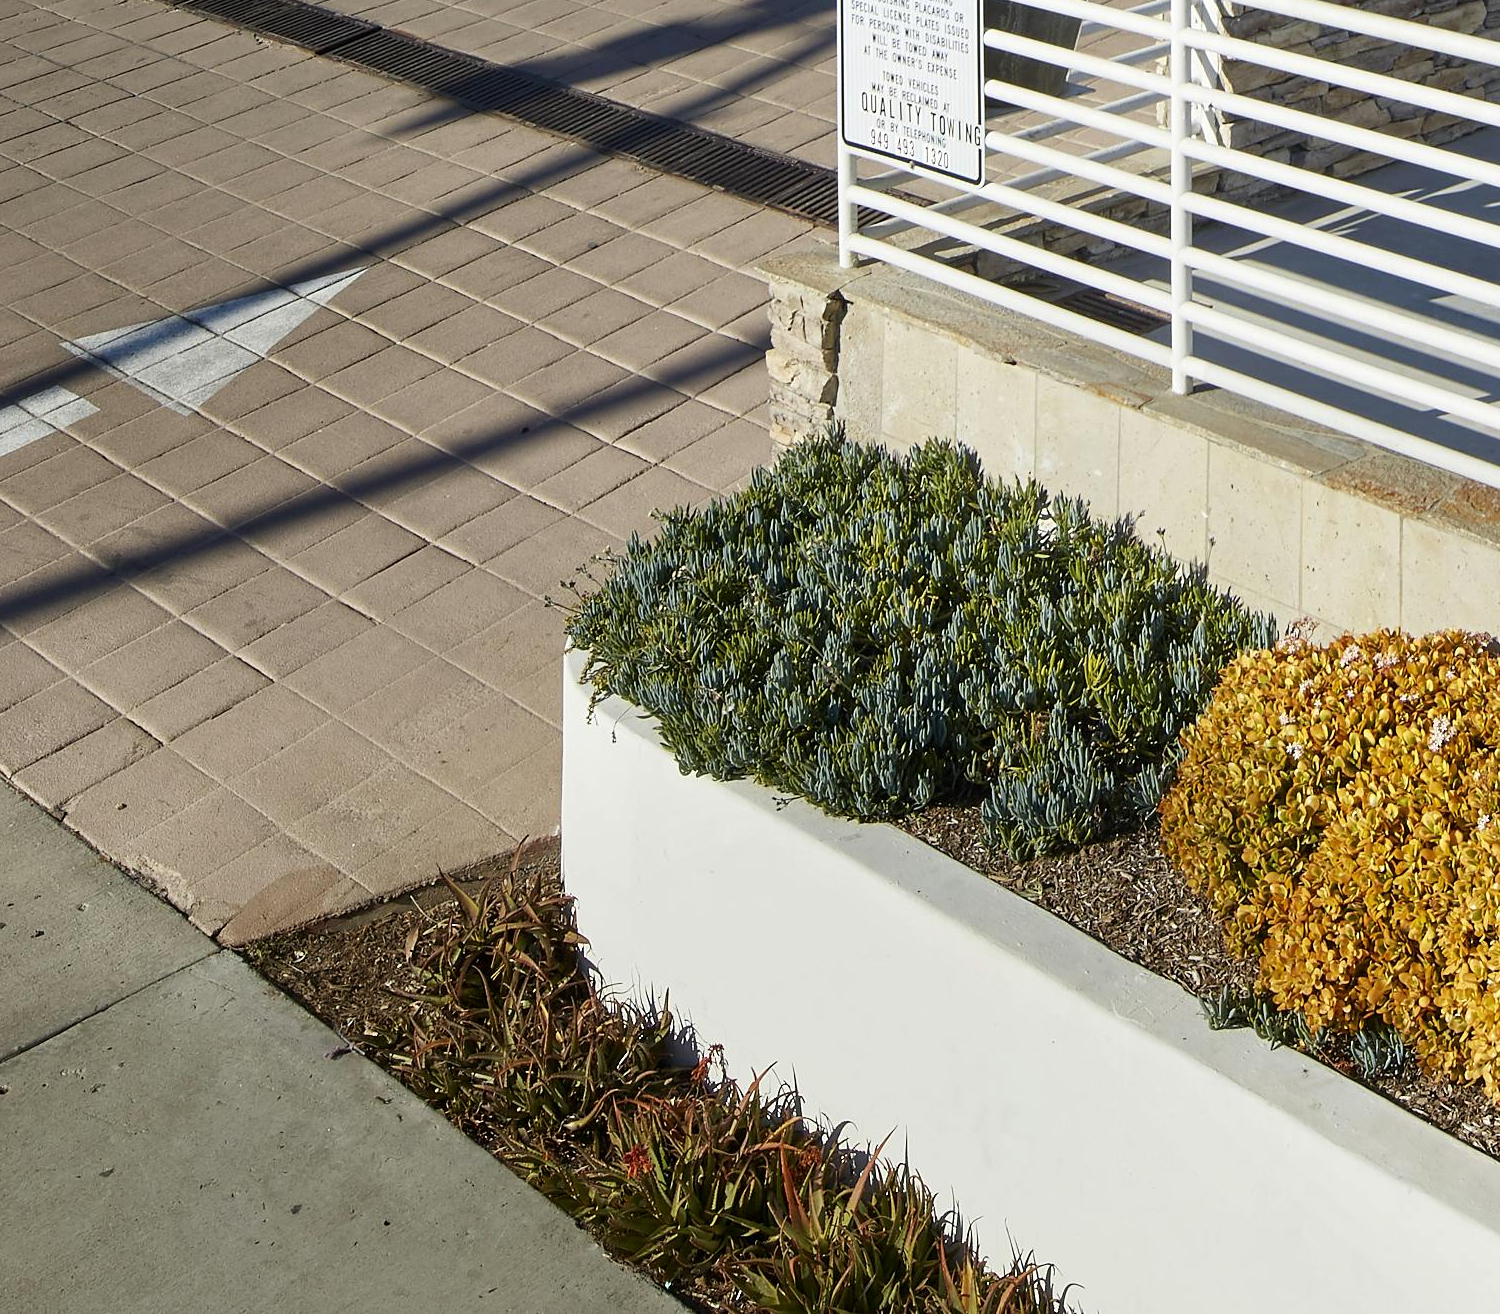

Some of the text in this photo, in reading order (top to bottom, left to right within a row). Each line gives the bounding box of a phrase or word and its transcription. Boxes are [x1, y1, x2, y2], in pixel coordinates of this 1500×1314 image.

[851, 0, 969, 39] SPECIAL LICENSE PLATES ISSUED
[915, 1, 949, 19] PLACARDS
[955, 12, 963, 23] OR
[851, 14, 969, 53] FOR PERSONS WITH DISABILITIES
[873, 34, 948, 62] WILL BE TOWED AWAY
[863, 45, 957, 80] AT THE OWNER'S EXPENSE
[871, 82, 949, 112] MAY BE RECLAIMED AT
[883, 70, 939, 95] TOWED VEHICLES
[861, 92, 981, 146] QUALITY TOWING
[876, 118, 946, 148] OR BY TELEPHONING
[871, 129, 949, 169] 949 493 1320
